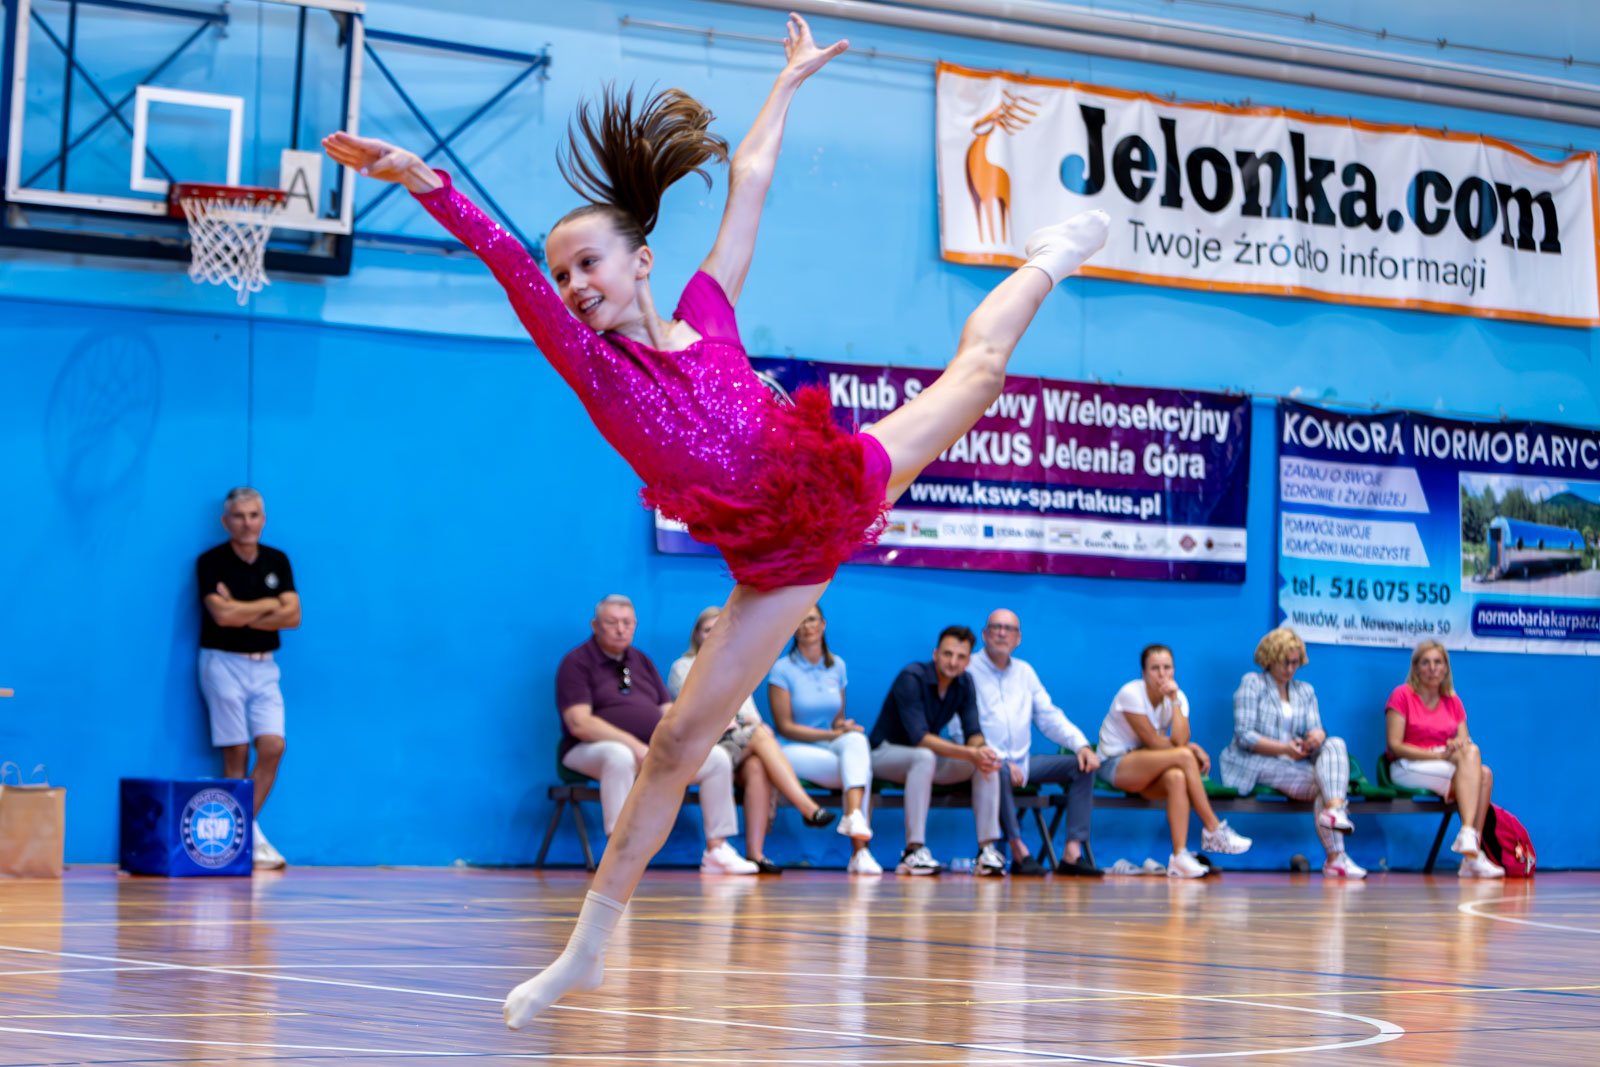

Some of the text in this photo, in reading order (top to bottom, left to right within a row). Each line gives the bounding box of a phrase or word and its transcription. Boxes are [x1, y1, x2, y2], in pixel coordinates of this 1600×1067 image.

[282, 167, 314, 213] A
[1059, 104, 1561, 254] Jelonka.com
[1129, 220, 1487, 297] Twoje źródło informacji
[829, 373, 897, 410] Klub
[1042, 388, 1230, 443] Wielosekcyjny
[1283, 411, 1600, 470] KOMORA NORMOBARYC
[1040, 435, 1136, 475] Jelenia
[1143, 443, 1206, 479] Góra
[1284, 483, 1335, 500] ZDROWIE
[1330, 470, 1341, 483] O
[1342, 470, 1383, 487] SWOJE
[910, 482, 1161, 520] www.ksw-spartakus.pl
[1336, 524, 1372, 540] SWOJE
[1340, 543, 1411, 561] MACIERZYSTE
[1292, 575, 1451, 605] tel. 516 075 550
[1344, 616, 1357, 629] ul.
[1361, 616, 1434, 636] Nowowiejska
[1437, 619, 1451, 634] 50
[1478, 608, 1600, 632] normobariakarpacz.
[197, 818, 230, 839] KSW
